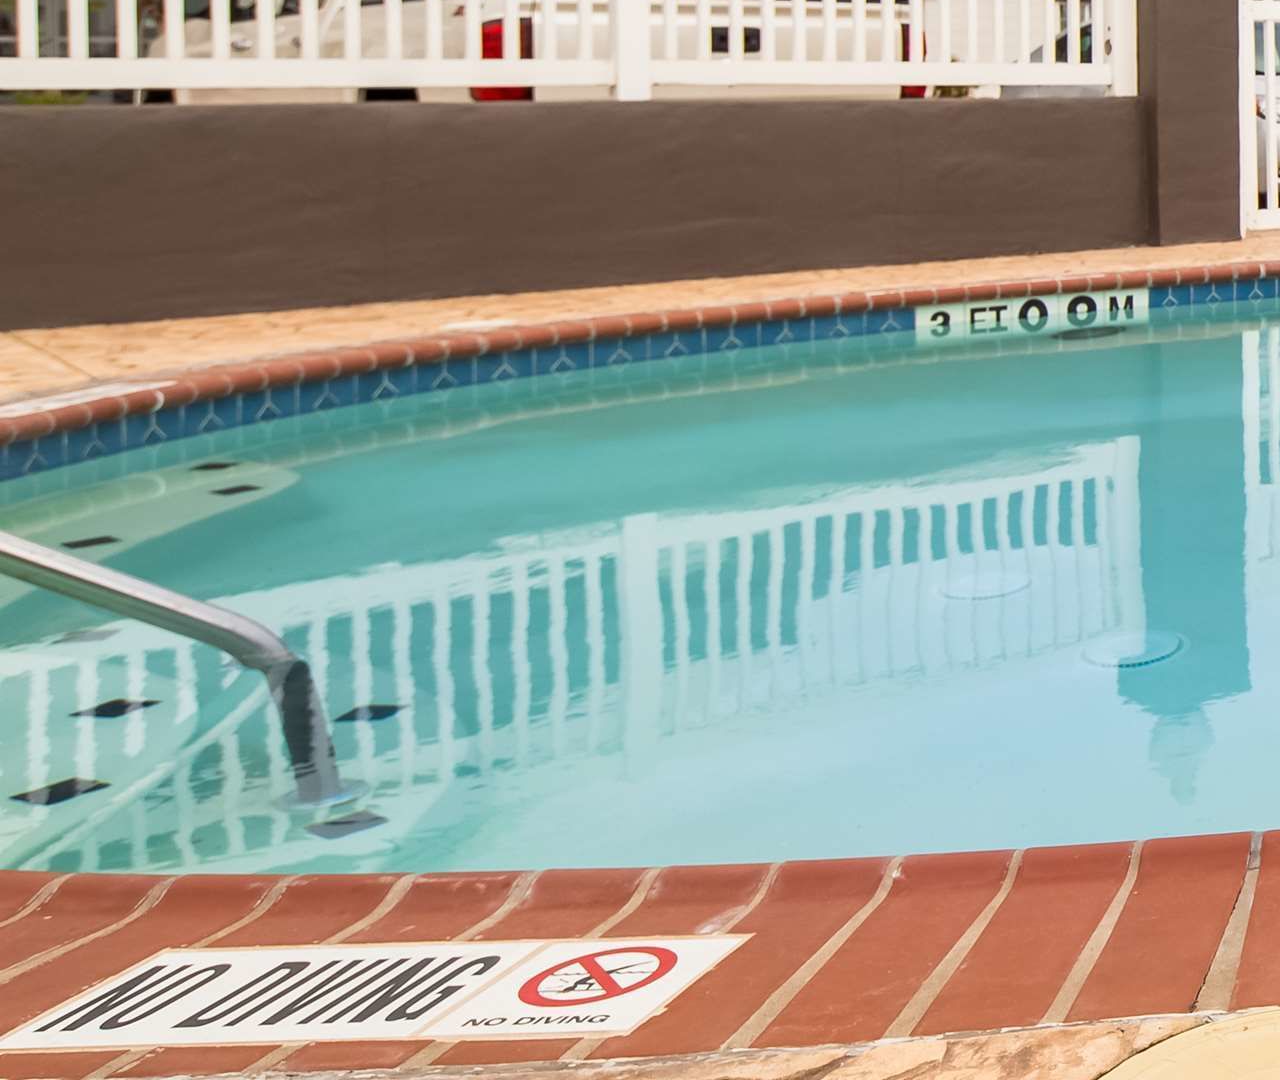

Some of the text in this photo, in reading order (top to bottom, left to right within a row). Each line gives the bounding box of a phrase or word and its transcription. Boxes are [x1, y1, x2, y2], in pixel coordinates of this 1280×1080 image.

[32, 955, 502, 1033] NO DIVING
[460, 1014, 611, 1028] NO DIVING
